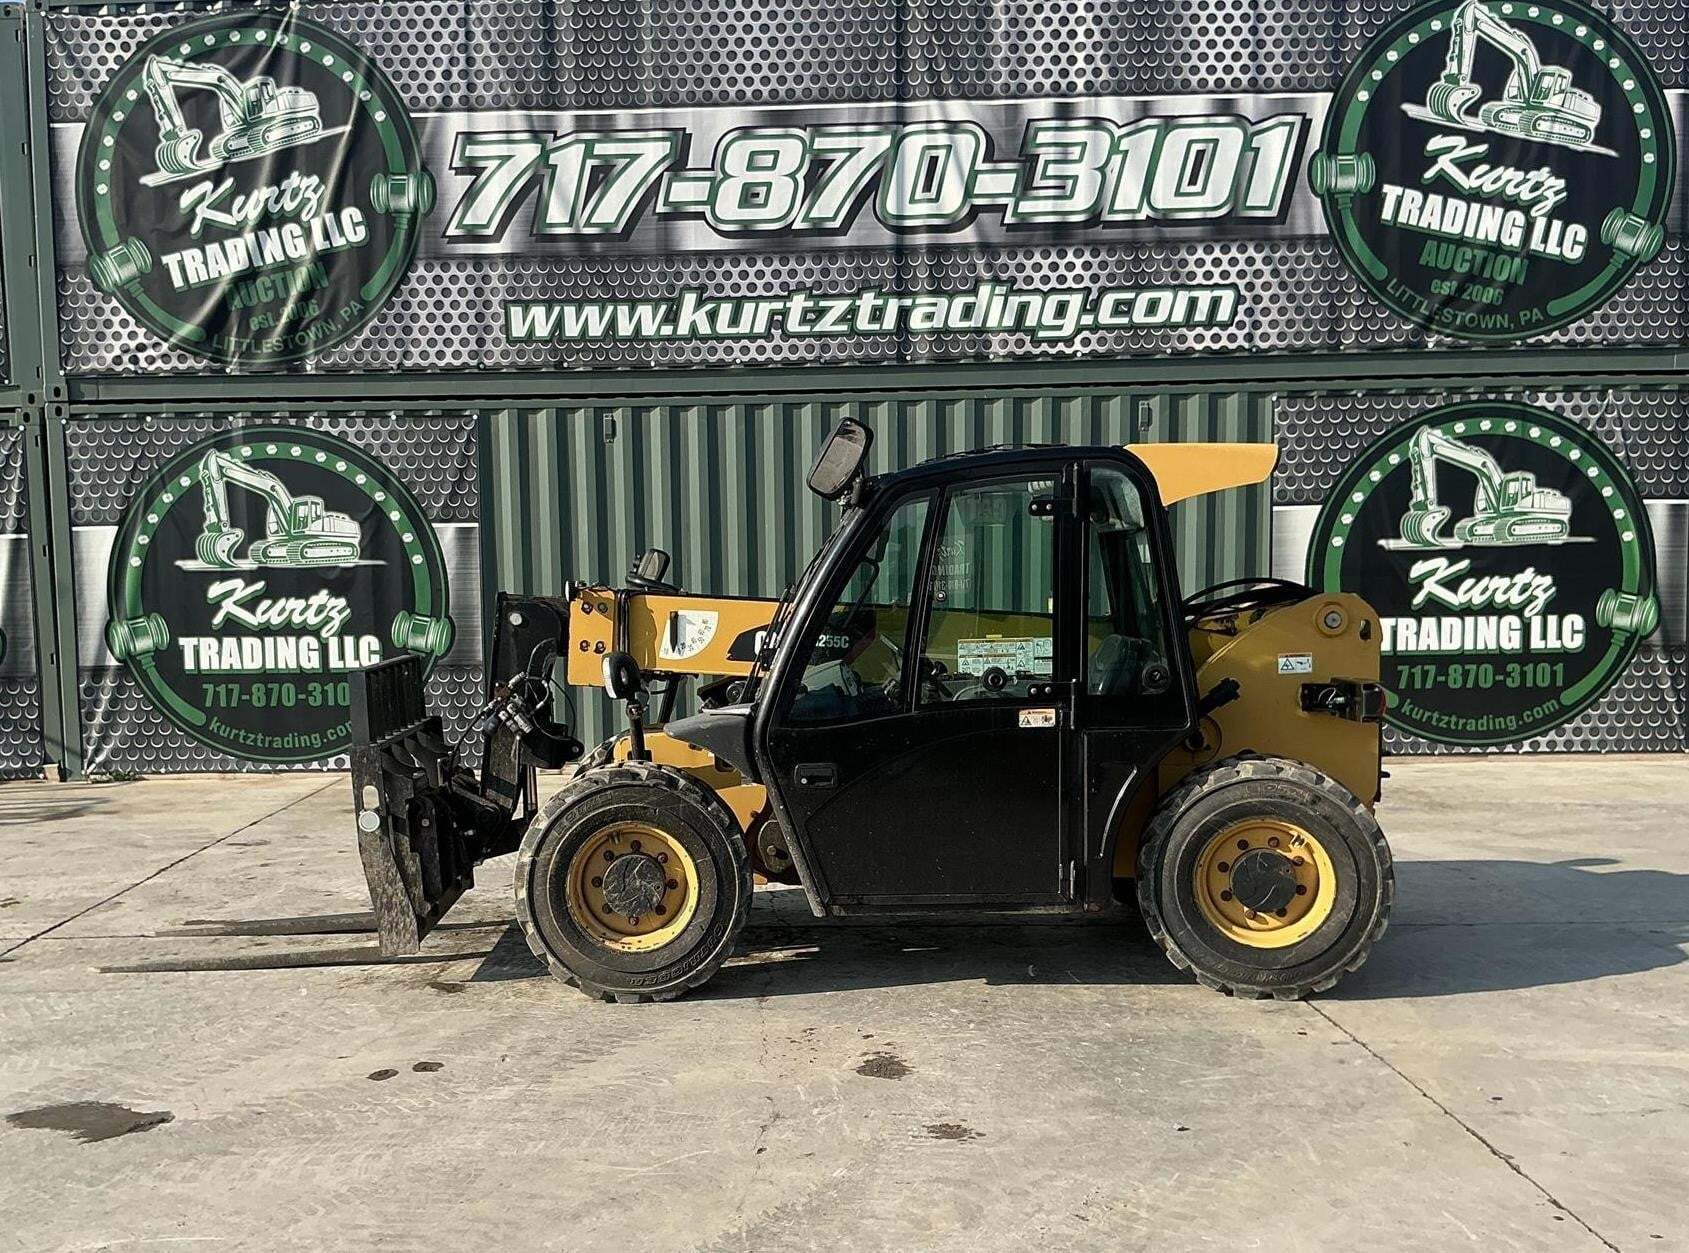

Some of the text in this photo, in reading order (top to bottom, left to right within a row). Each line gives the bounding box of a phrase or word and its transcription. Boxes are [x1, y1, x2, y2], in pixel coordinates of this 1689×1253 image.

[447, 114, 1304, 239] 717-870-3101
[1423, 134, 1567, 217] Kurtz
[180, 171, 326, 238] Kurtz
[1381, 184, 1588, 262] TRADING LLC
[161, 206, 368, 291] TRADING LLC
[1418, 240, 1529, 286] AUCTION
[227, 262, 329, 309] AUCTION
[340, 299, 365, 323] PA
[505, 285, 1238, 342] www.kurtztrading.com
[1519, 307, 1545, 326] PA
[207, 578, 350, 637] Kurtz
[1409, 556, 1556, 617] Kurtz
[179, 635, 382, 672] TRADING LLC
[815, 634, 849, 648] 255C
[1381, 614, 1586, 652] TRADING LLC
[202, 682, 351, 708] 717-870-310
[1397, 662, 1565, 690] 717-870-3101
[1401, 698, 1560, 731] kurtztrading.com
